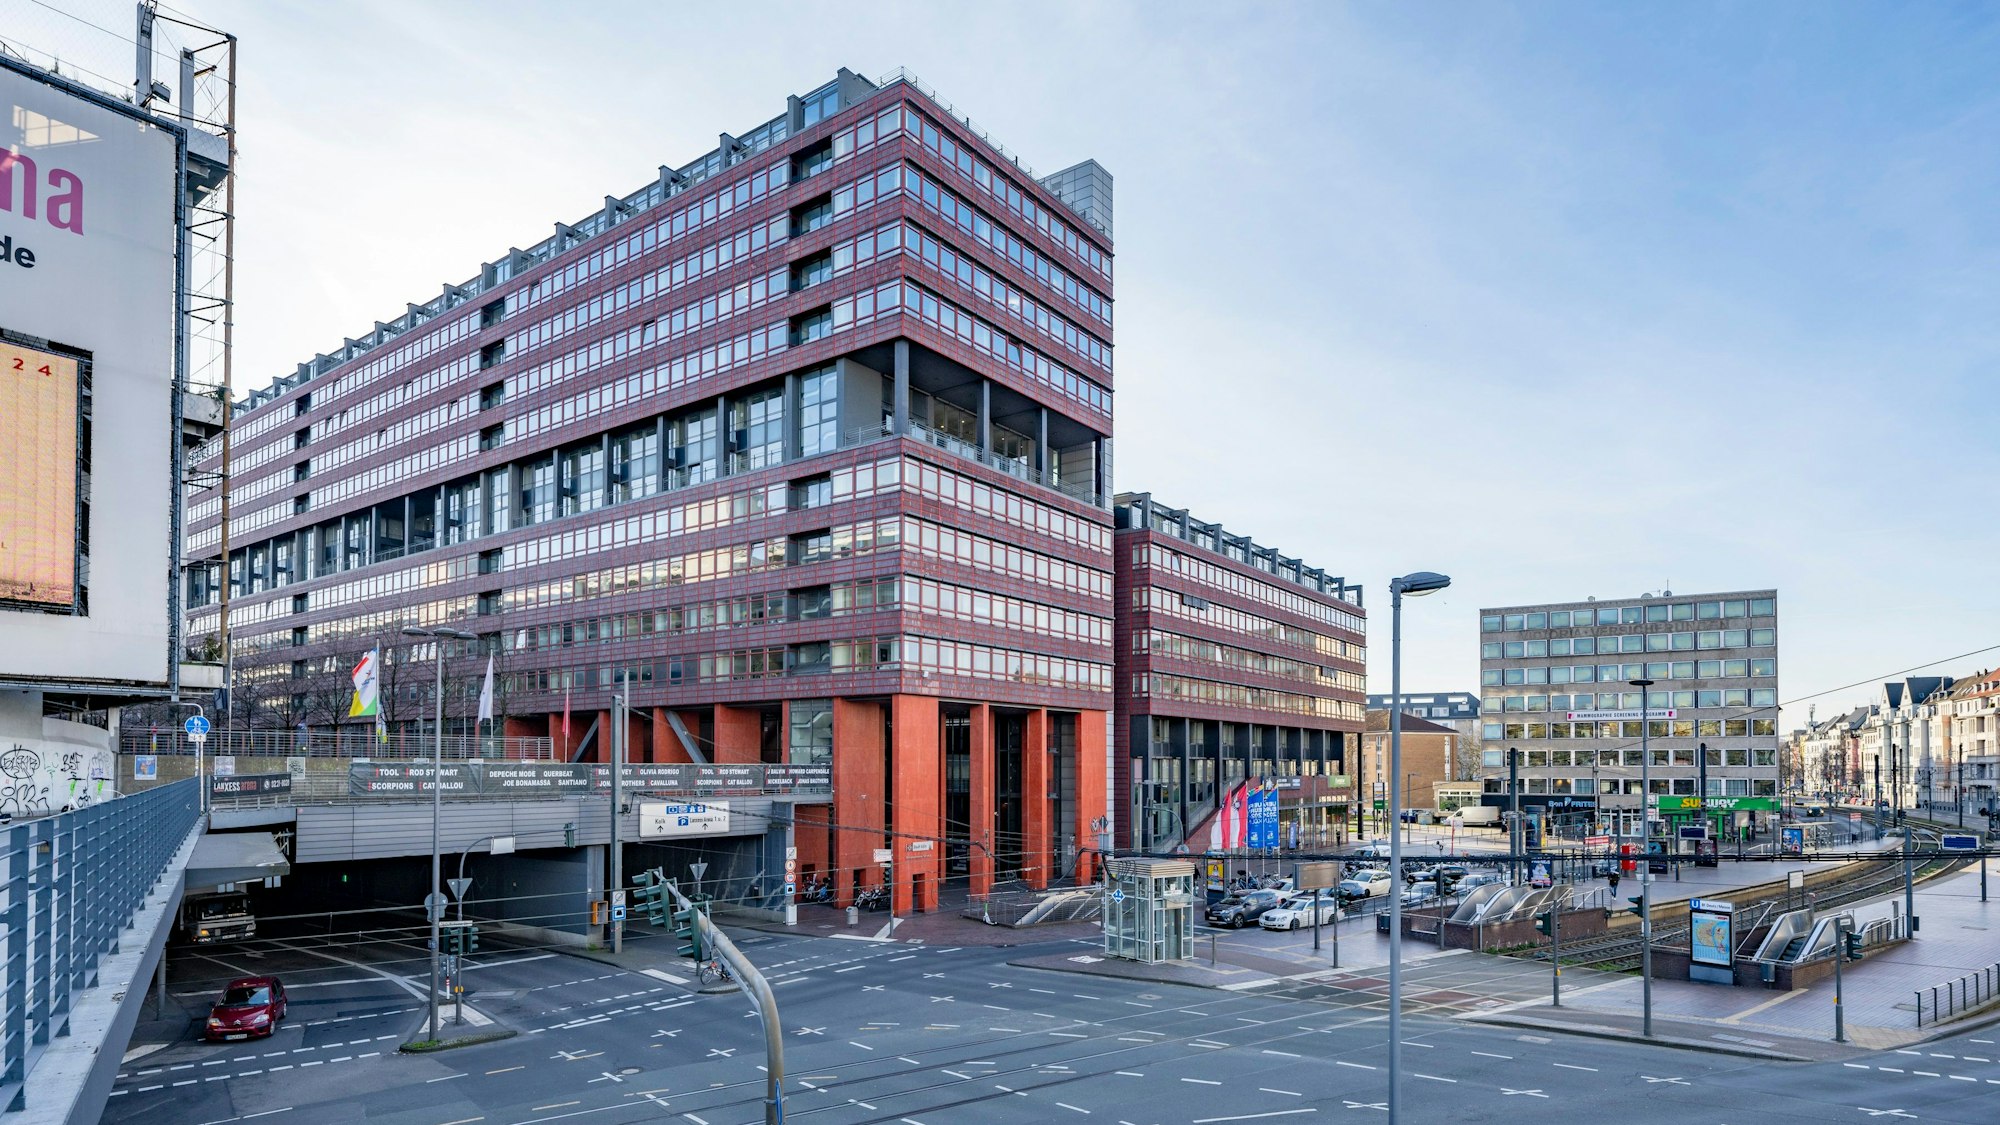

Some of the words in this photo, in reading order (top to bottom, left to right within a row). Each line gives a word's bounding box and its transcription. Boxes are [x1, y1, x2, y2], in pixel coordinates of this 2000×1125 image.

[379, 768, 400, 776] TOOL
[409, 768, 425, 776] ROD
[425, 768, 458, 776] STWART
[489, 770, 518, 778] DEPECHE
[598, 768, 610, 776] REA
[213, 781, 241, 792] LANXESS
[371, 782, 414, 790] SCORPIONS
[422, 782, 435, 790] CAT
[1680, 797, 1739, 809] SUWAY
